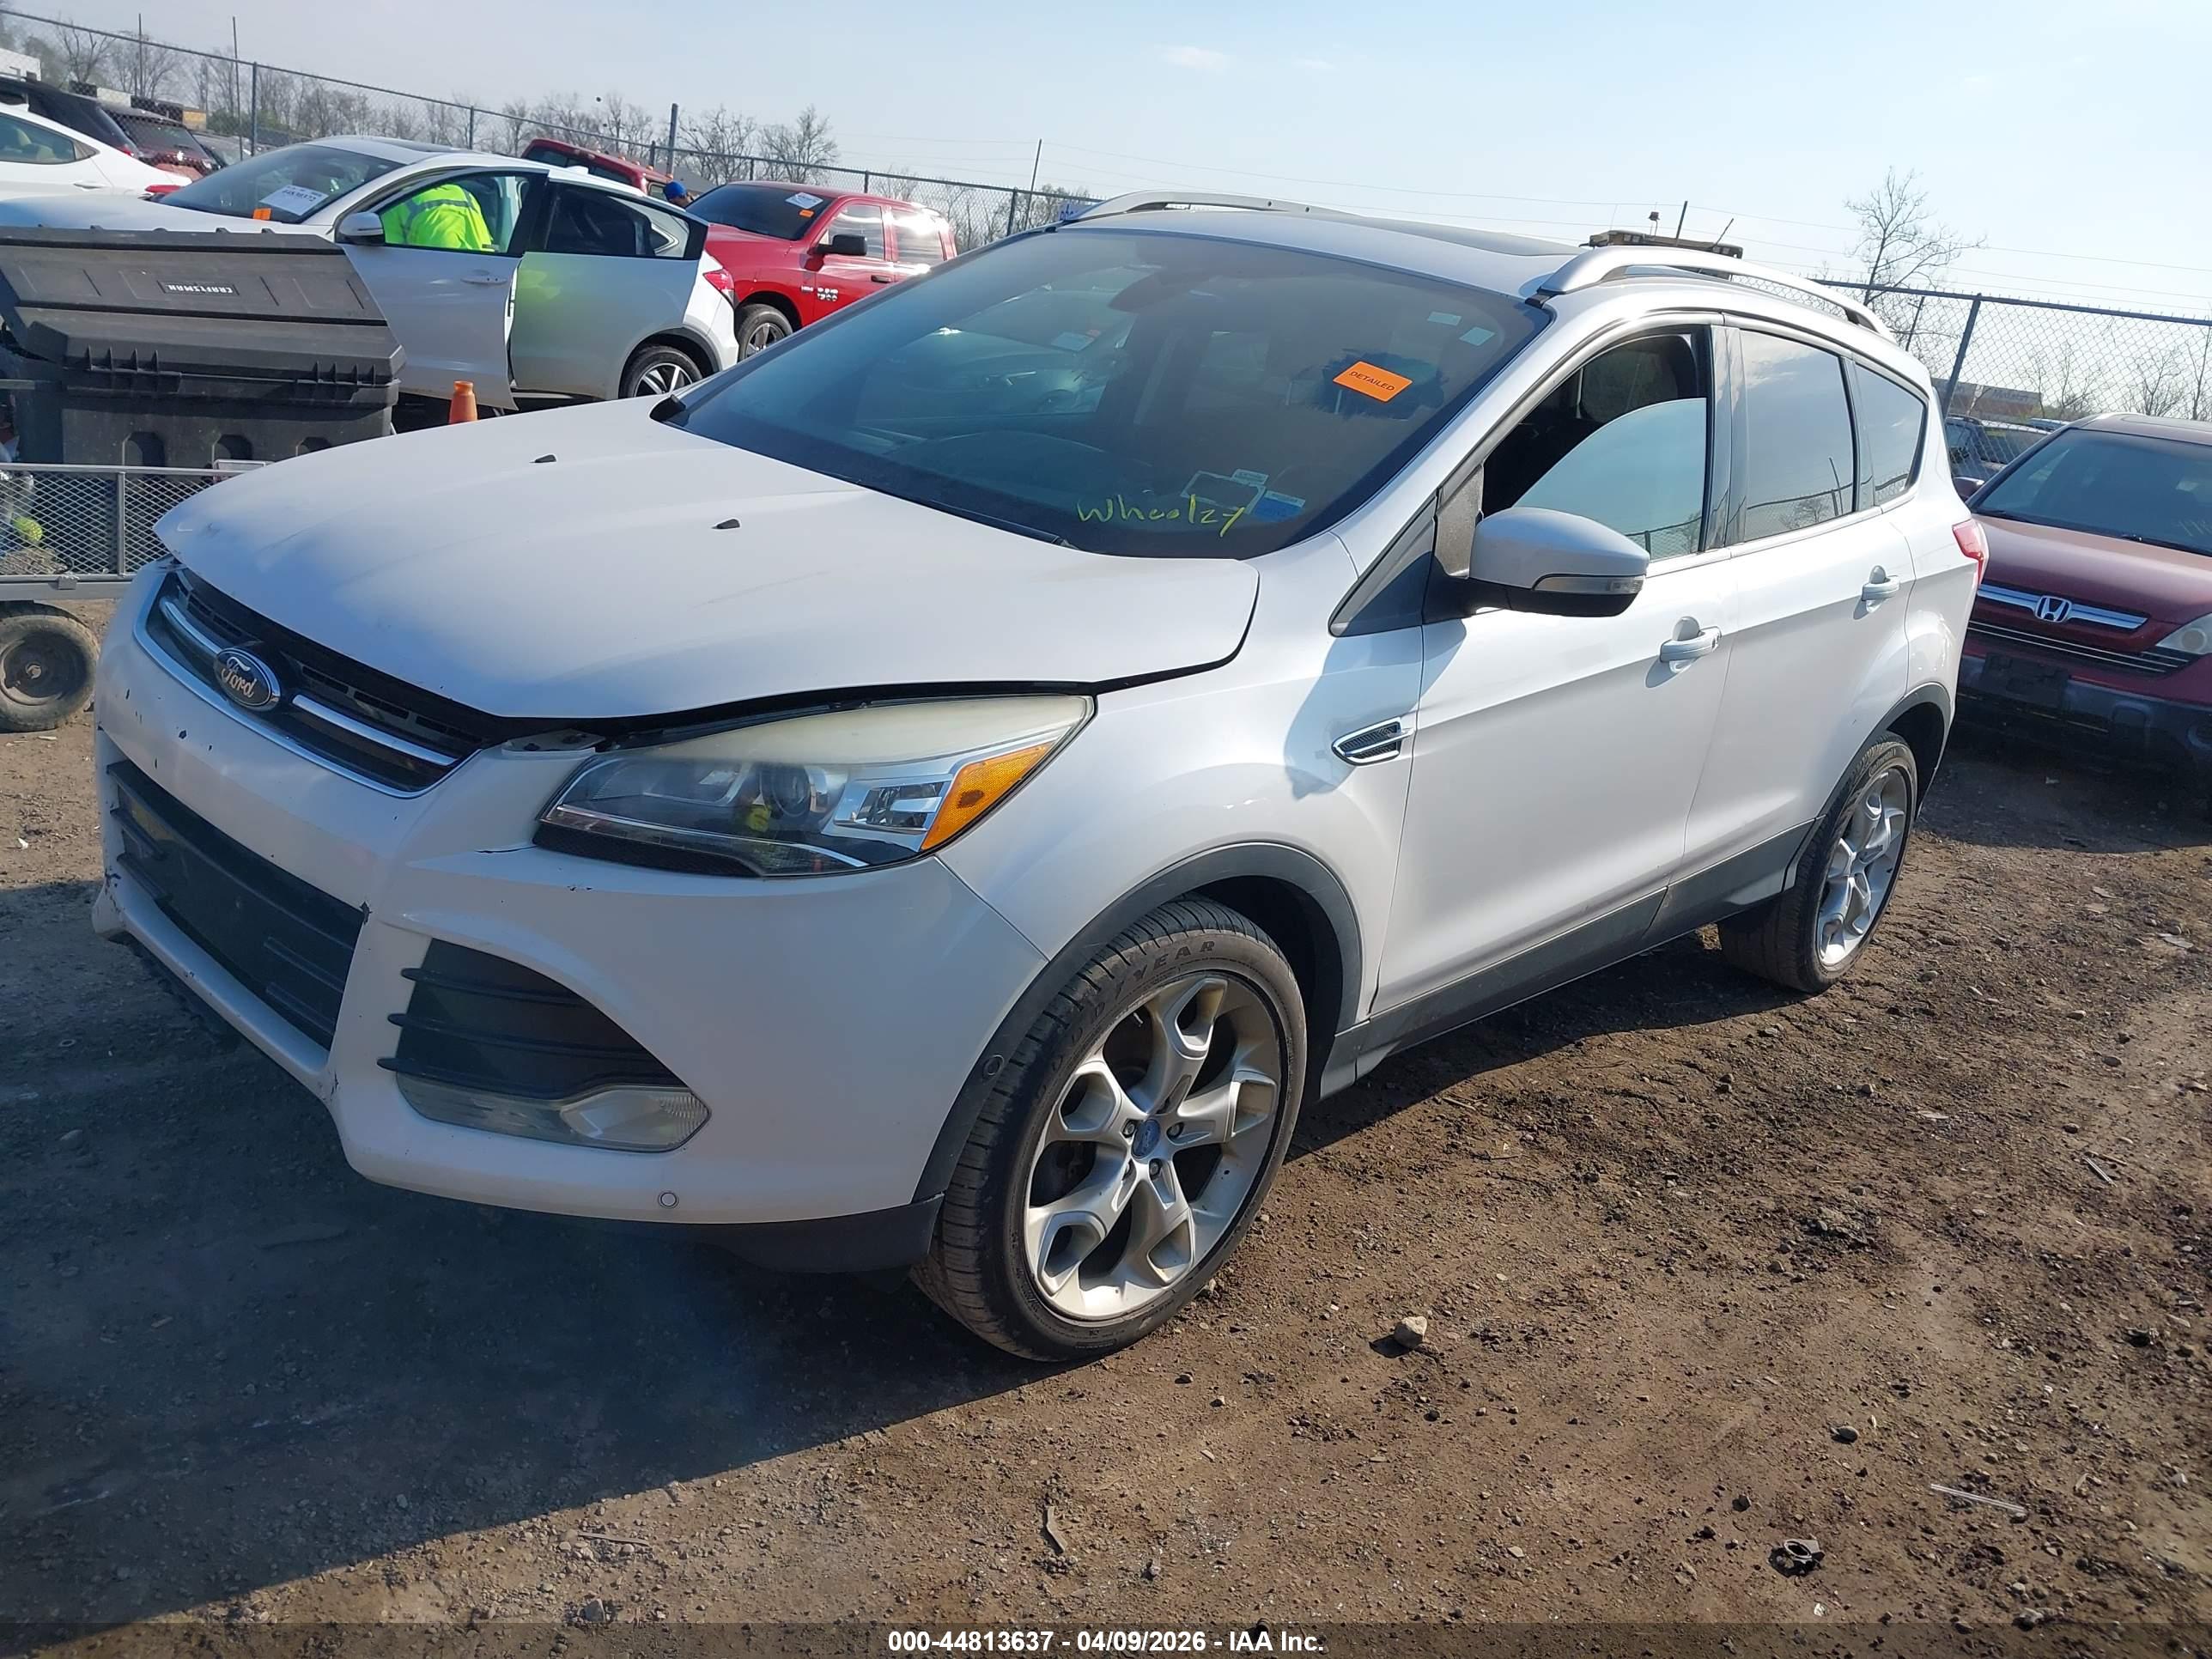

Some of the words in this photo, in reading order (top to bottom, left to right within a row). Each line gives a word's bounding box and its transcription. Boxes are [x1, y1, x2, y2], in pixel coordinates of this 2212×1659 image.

[166, 284, 234, 294] CRAFTSMAN
[1349, 371, 1395, 392] DETAILED
[221, 656, 258, 698] Ford
